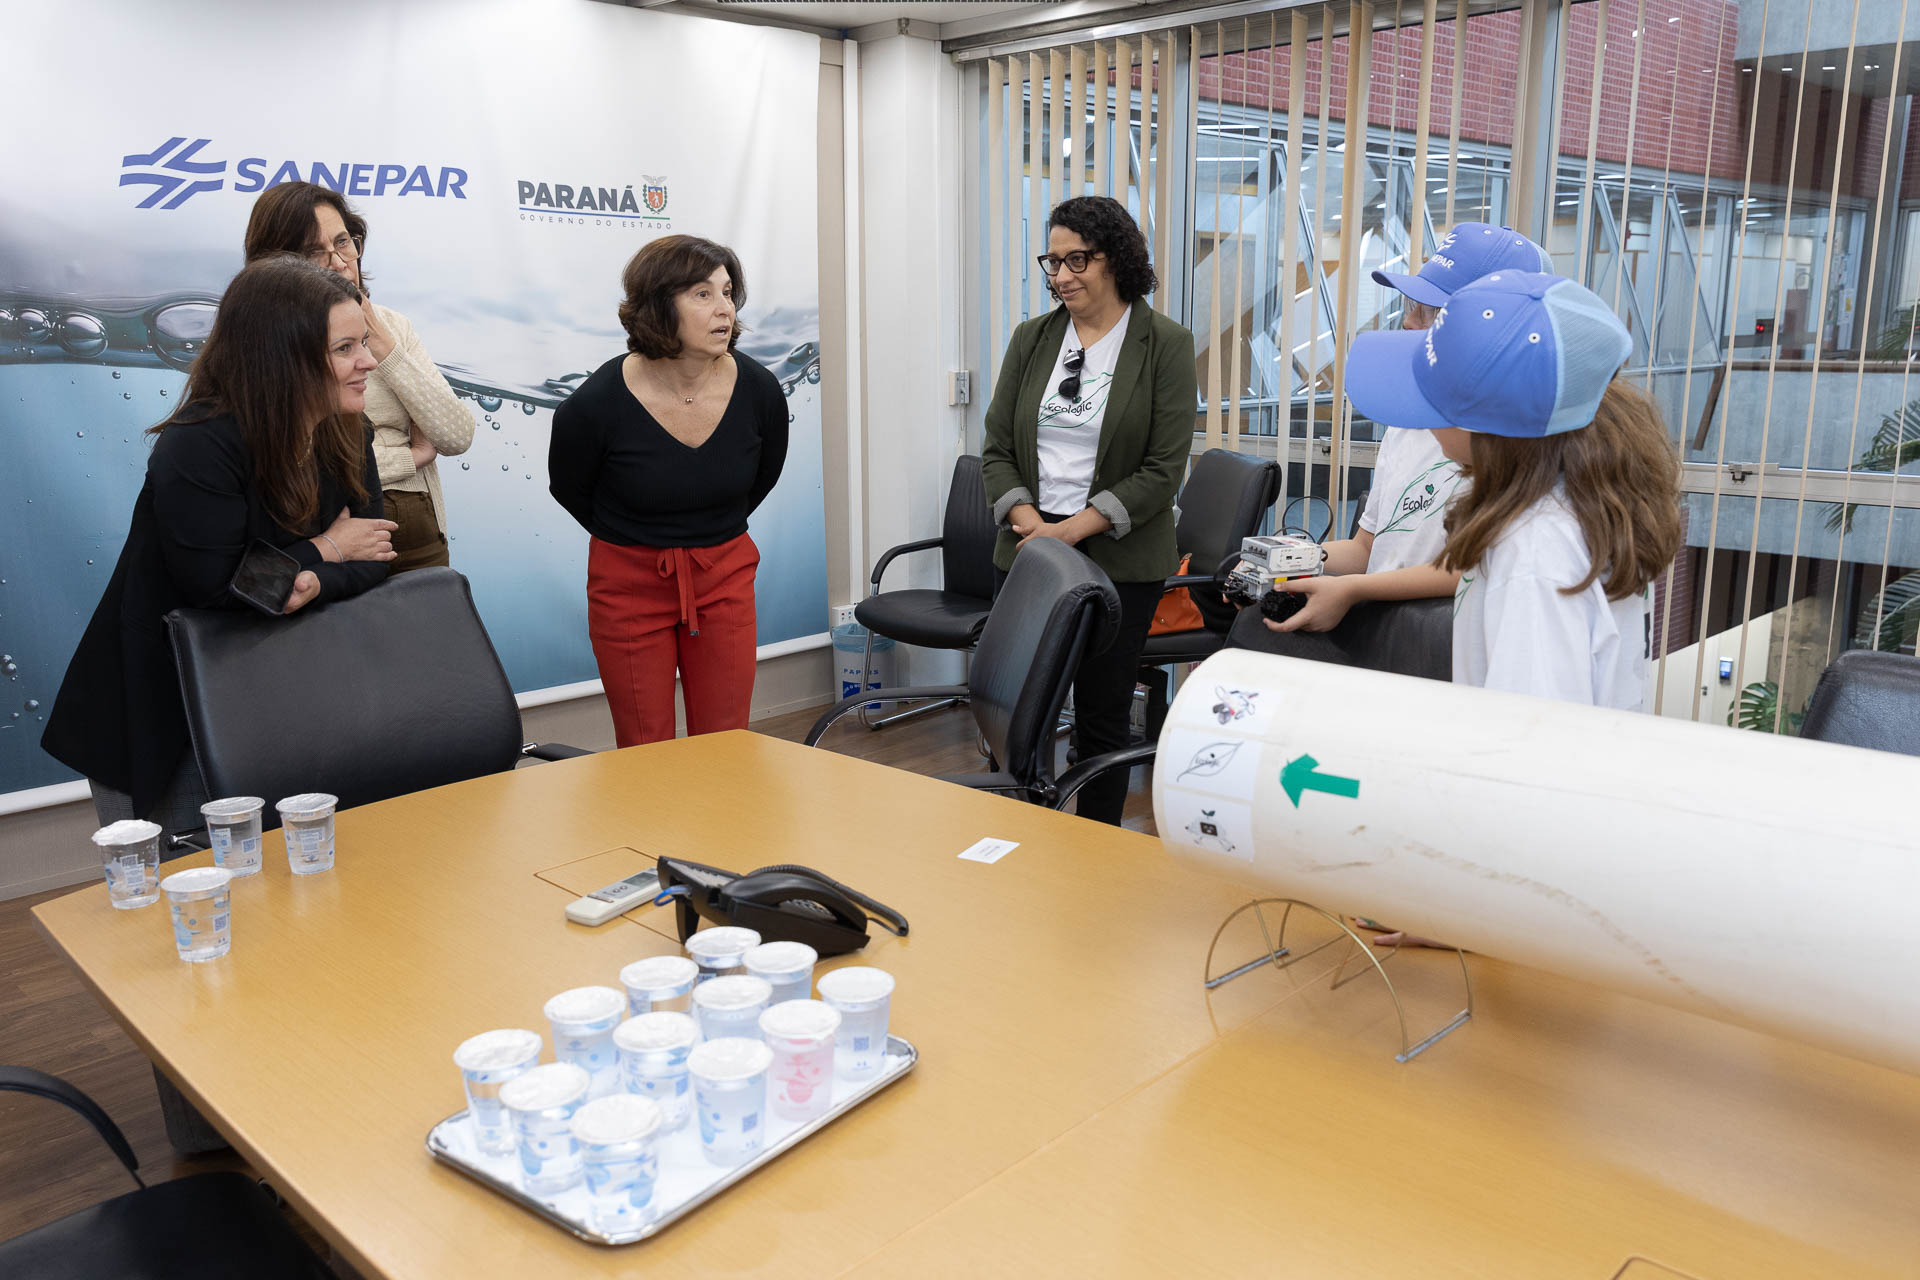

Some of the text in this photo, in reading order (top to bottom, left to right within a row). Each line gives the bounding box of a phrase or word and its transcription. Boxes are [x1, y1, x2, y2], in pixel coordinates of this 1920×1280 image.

[234, 157, 468, 200] SANEPAR
[517, 179, 640, 214] PARANÁ
[519, 213, 672, 230] GOVERNO DO ESTADO
[1047, 401, 1092, 416] Ecologic
